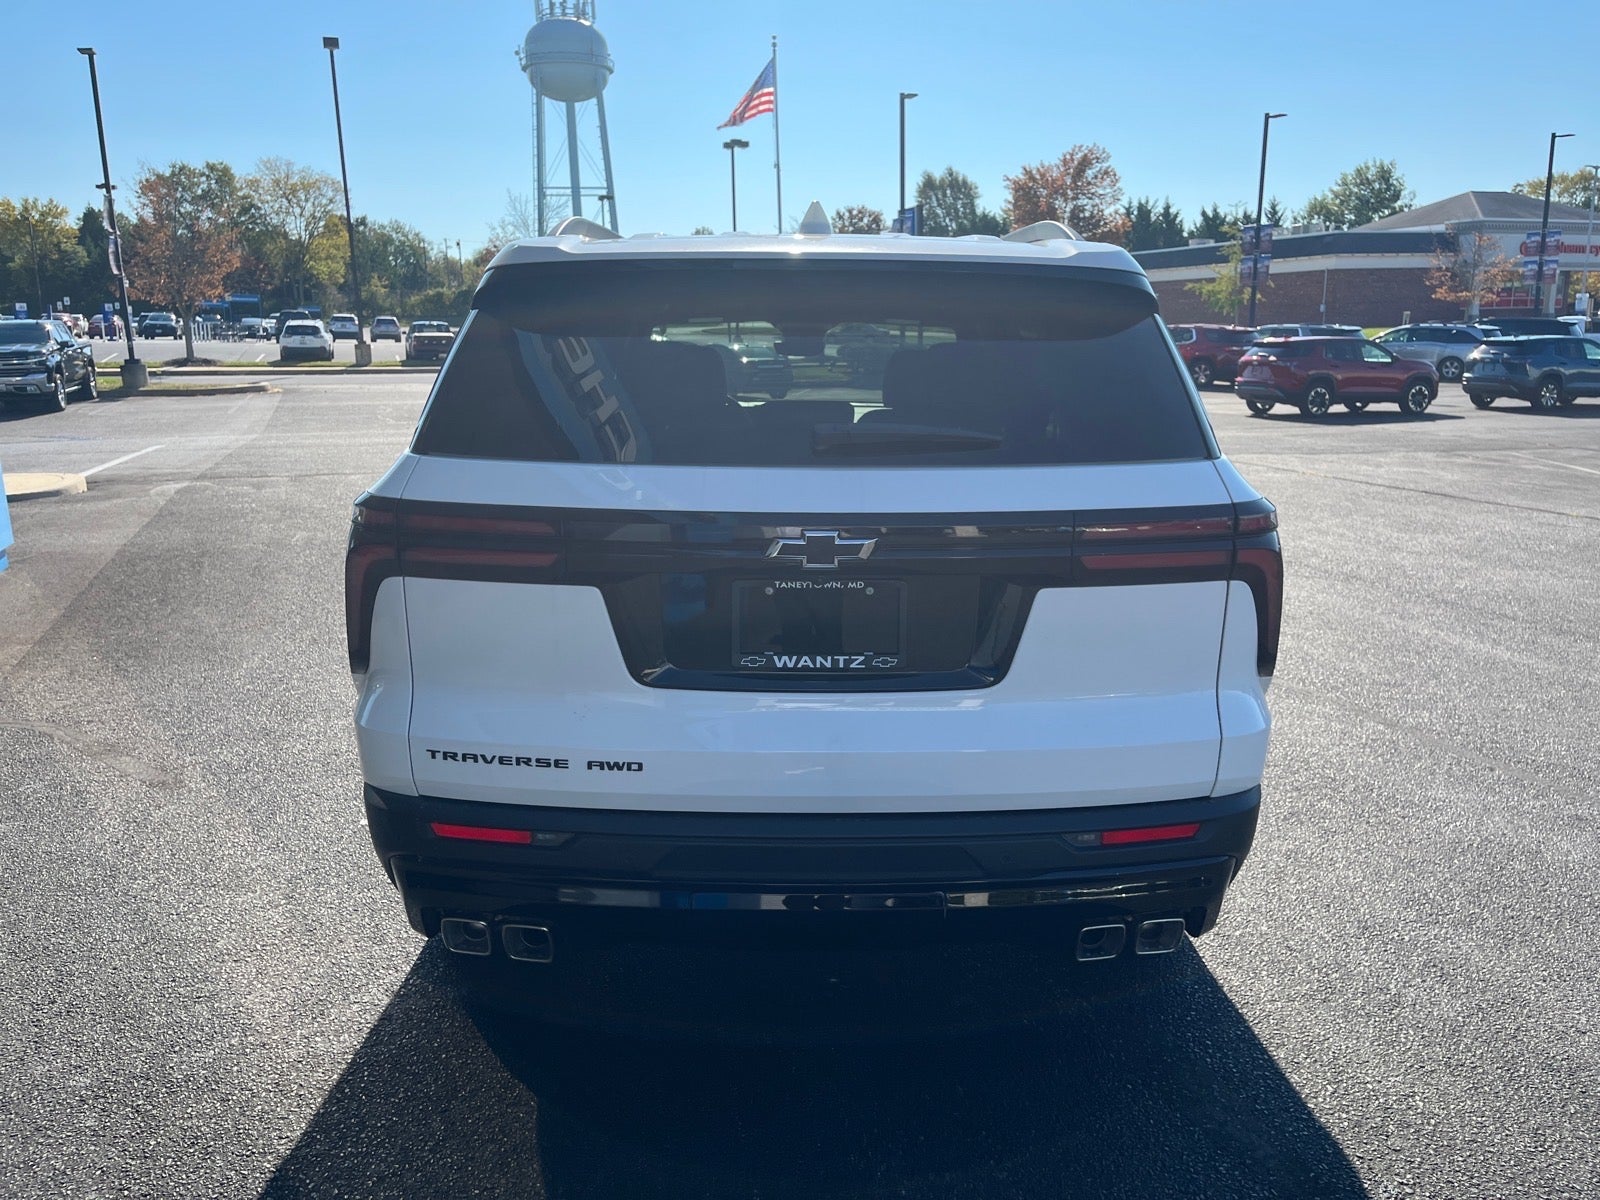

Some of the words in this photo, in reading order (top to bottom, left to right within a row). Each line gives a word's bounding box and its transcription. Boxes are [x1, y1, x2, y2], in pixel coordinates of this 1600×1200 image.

[847, 581, 865, 589] MD
[773, 655, 866, 668] WANTZ
[426, 749, 569, 769] TRAVERSE
[587, 760, 644, 772] AWD
